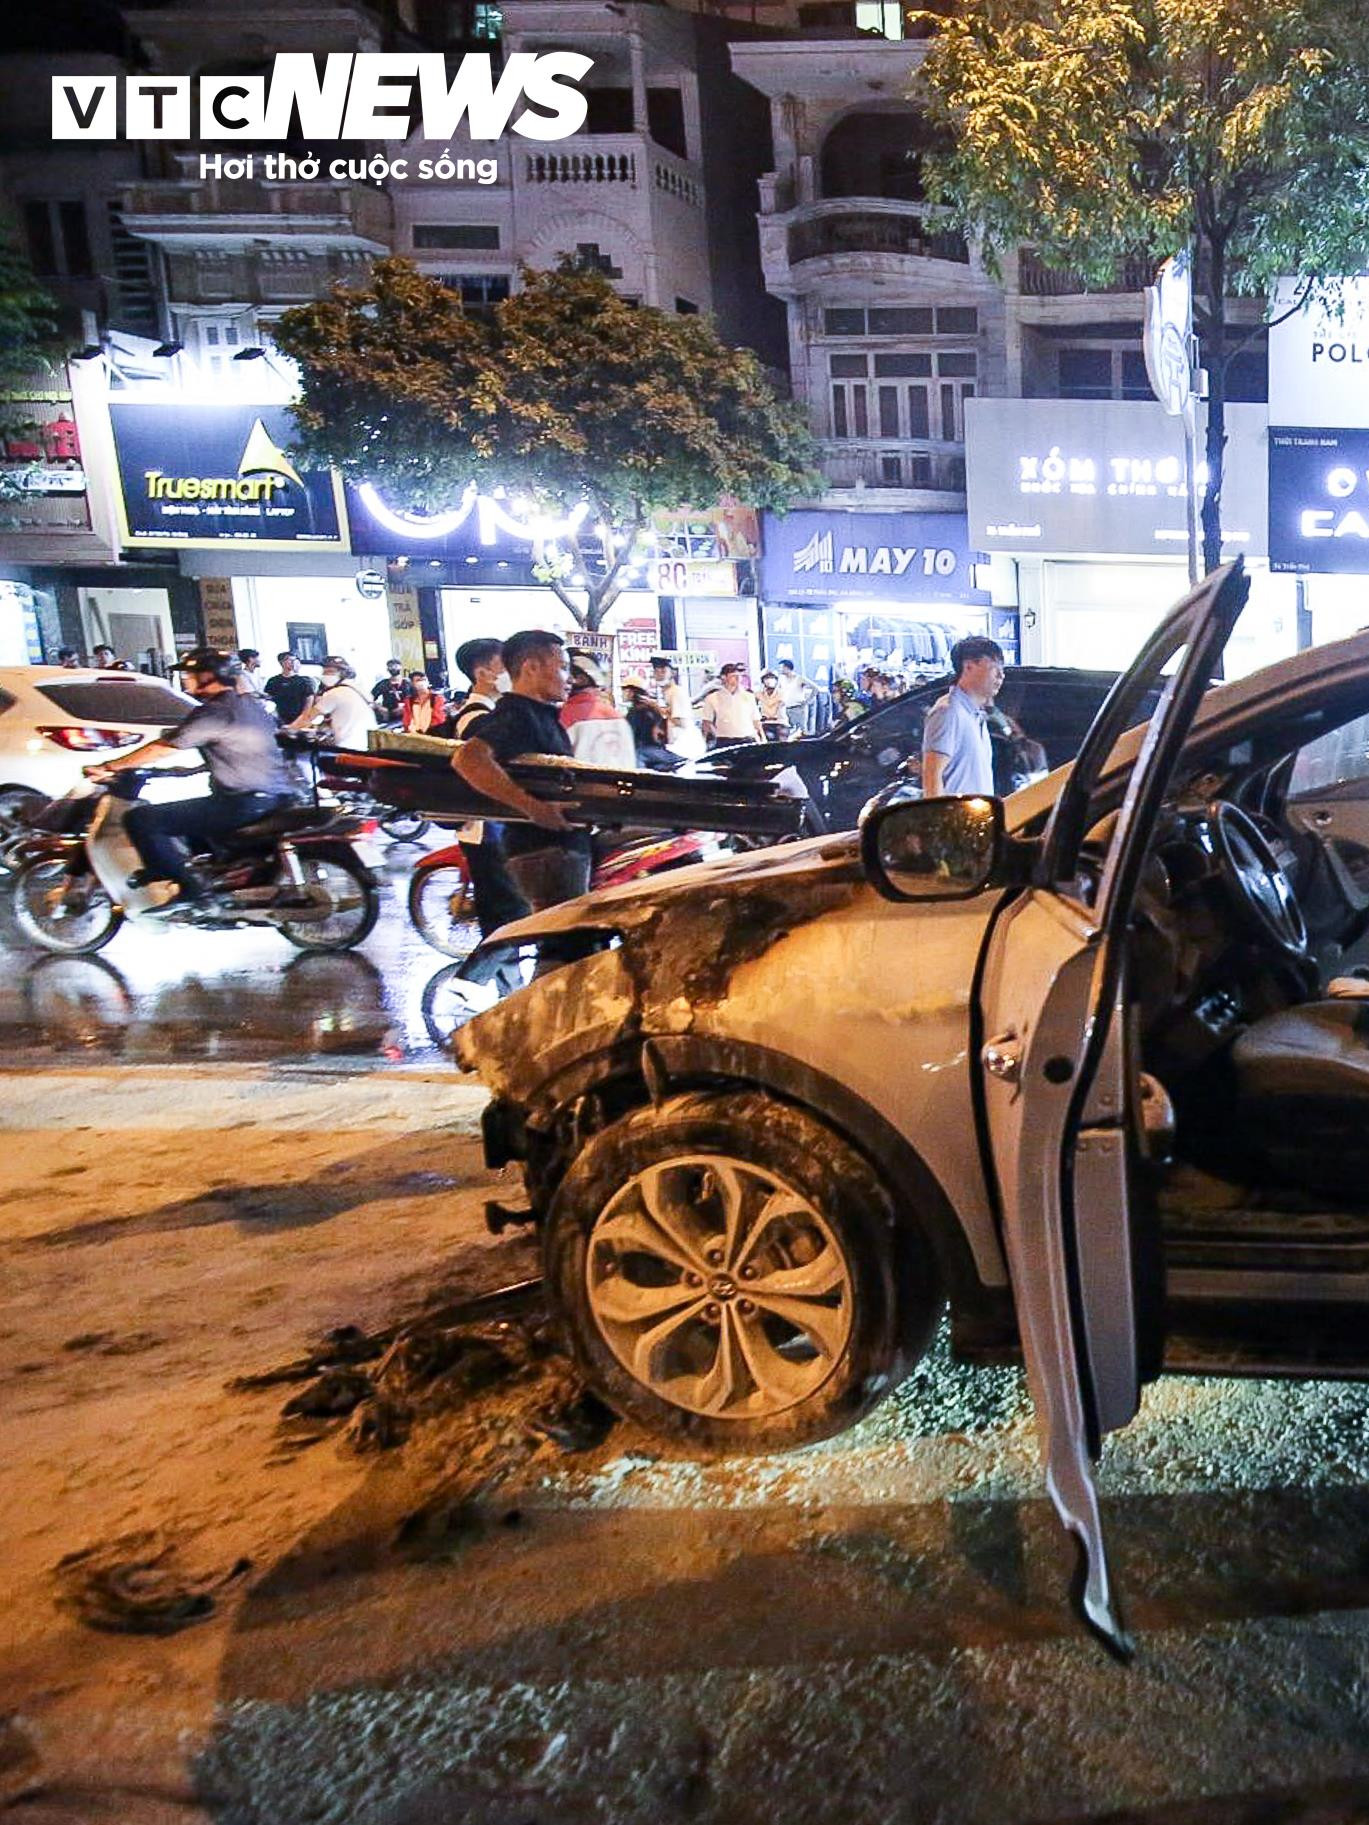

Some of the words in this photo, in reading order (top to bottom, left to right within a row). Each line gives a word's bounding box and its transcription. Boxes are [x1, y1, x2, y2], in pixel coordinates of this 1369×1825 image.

[1018, 446, 1095, 482] XÓM
[144, 469, 274, 500] Truesmart
[839, 547, 916, 575] MAY
[922, 548, 957, 576] 10
